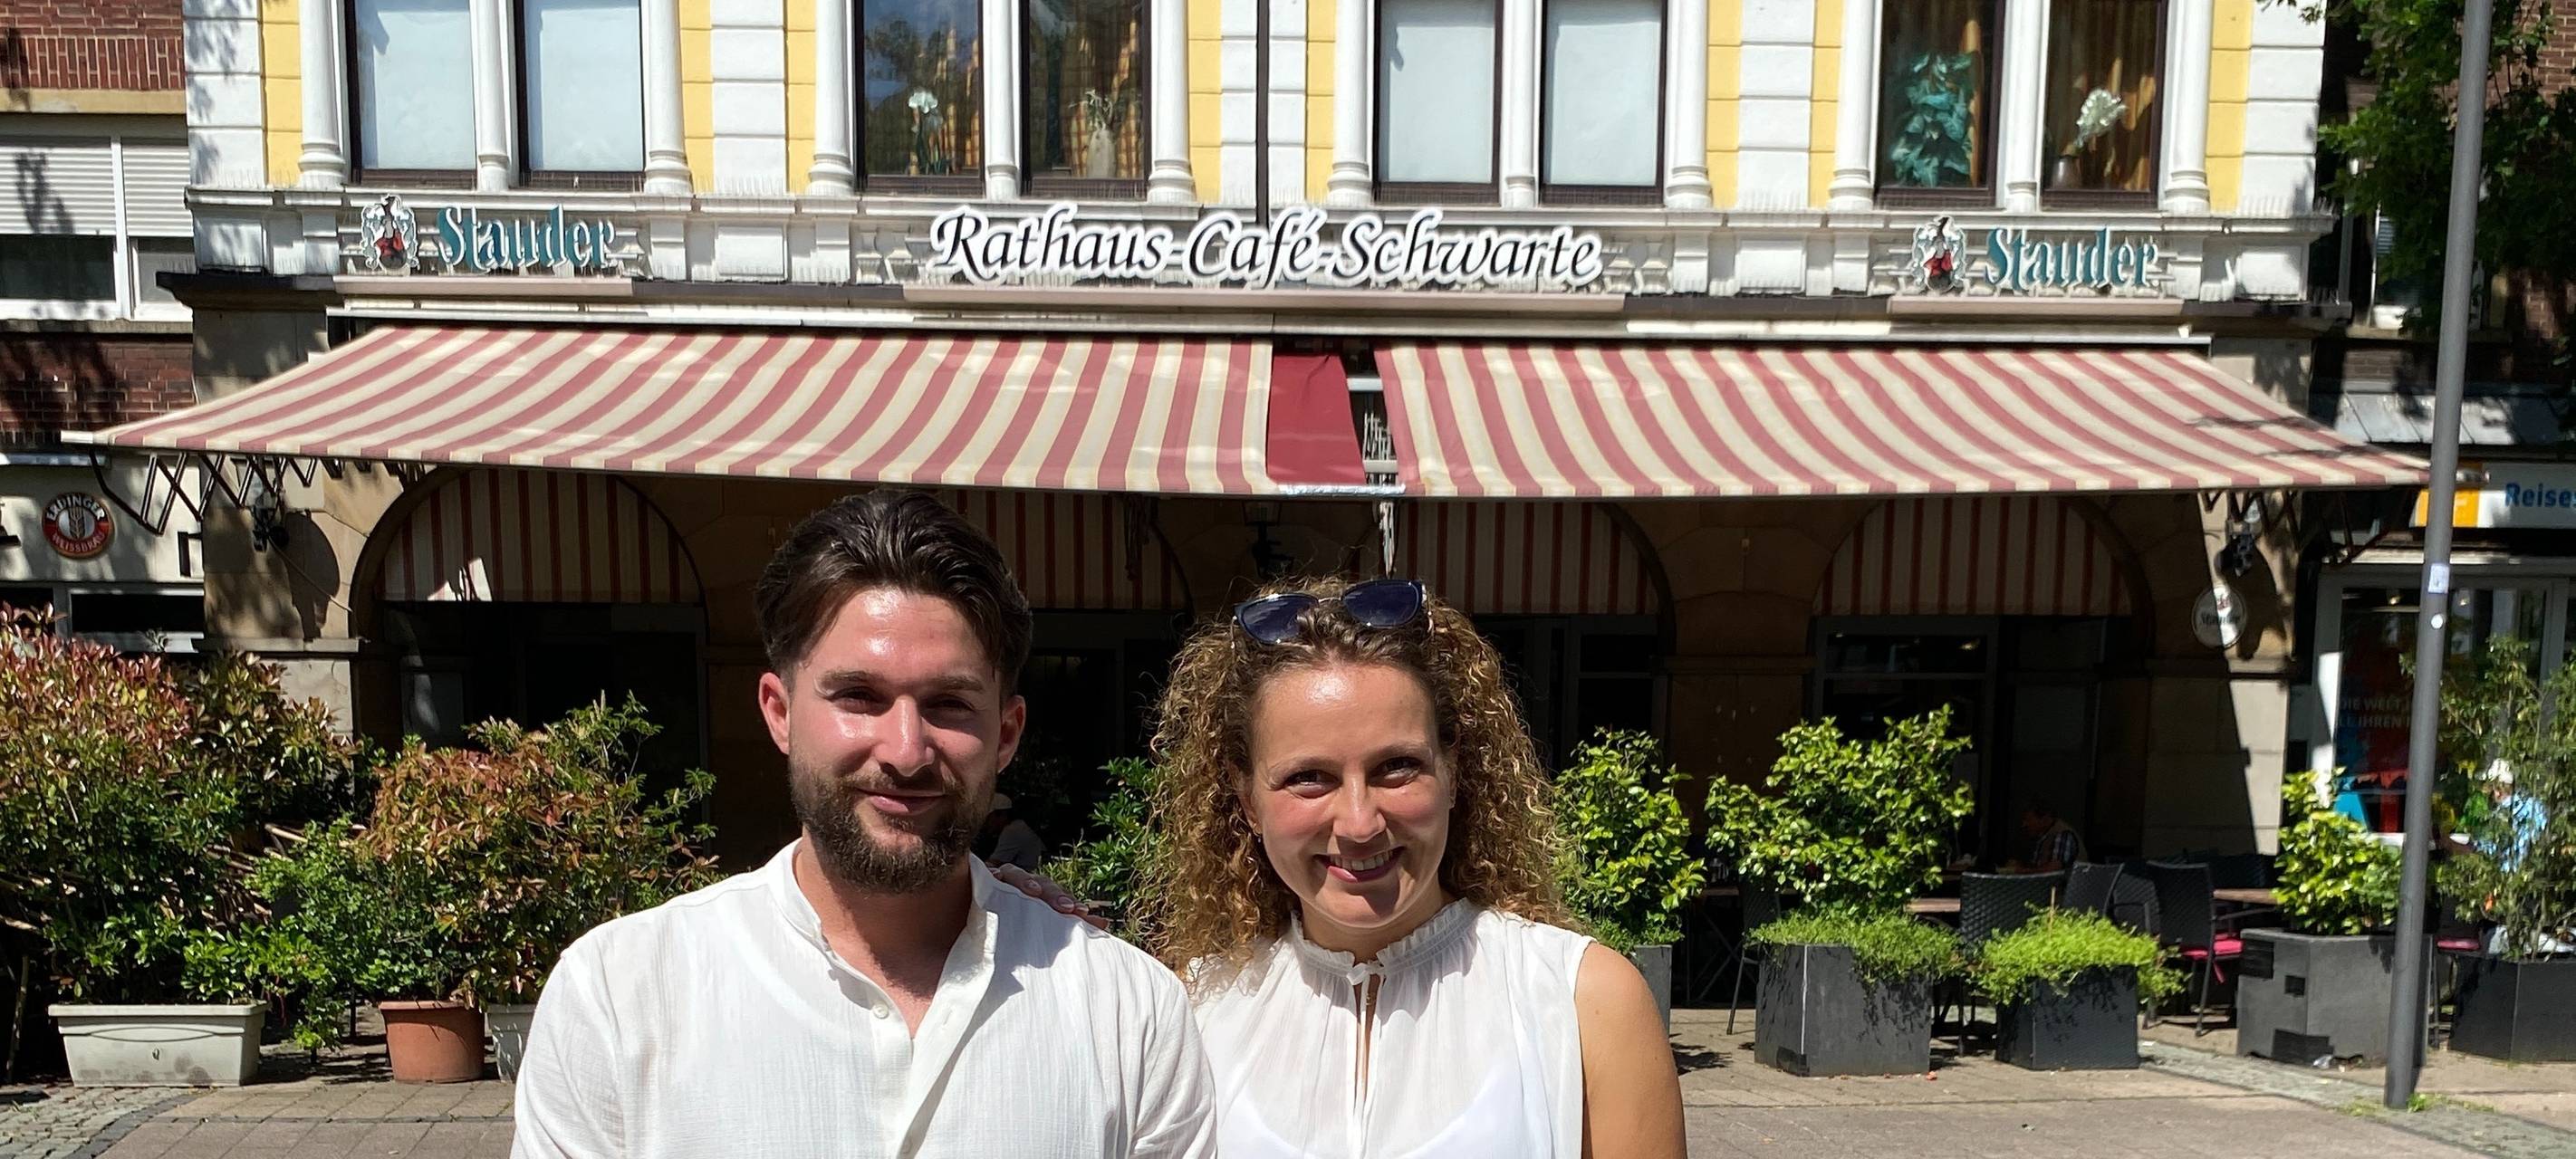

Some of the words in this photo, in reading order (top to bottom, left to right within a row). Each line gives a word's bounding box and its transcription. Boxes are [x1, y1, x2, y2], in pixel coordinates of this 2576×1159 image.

[437, 205, 615, 271] Stauder
[933, 206, 1599, 286] Rathaus-Café-Schwarte
[1985, 225, 2159, 291] Stauder
[46, 495, 105, 521] ERDINGER
